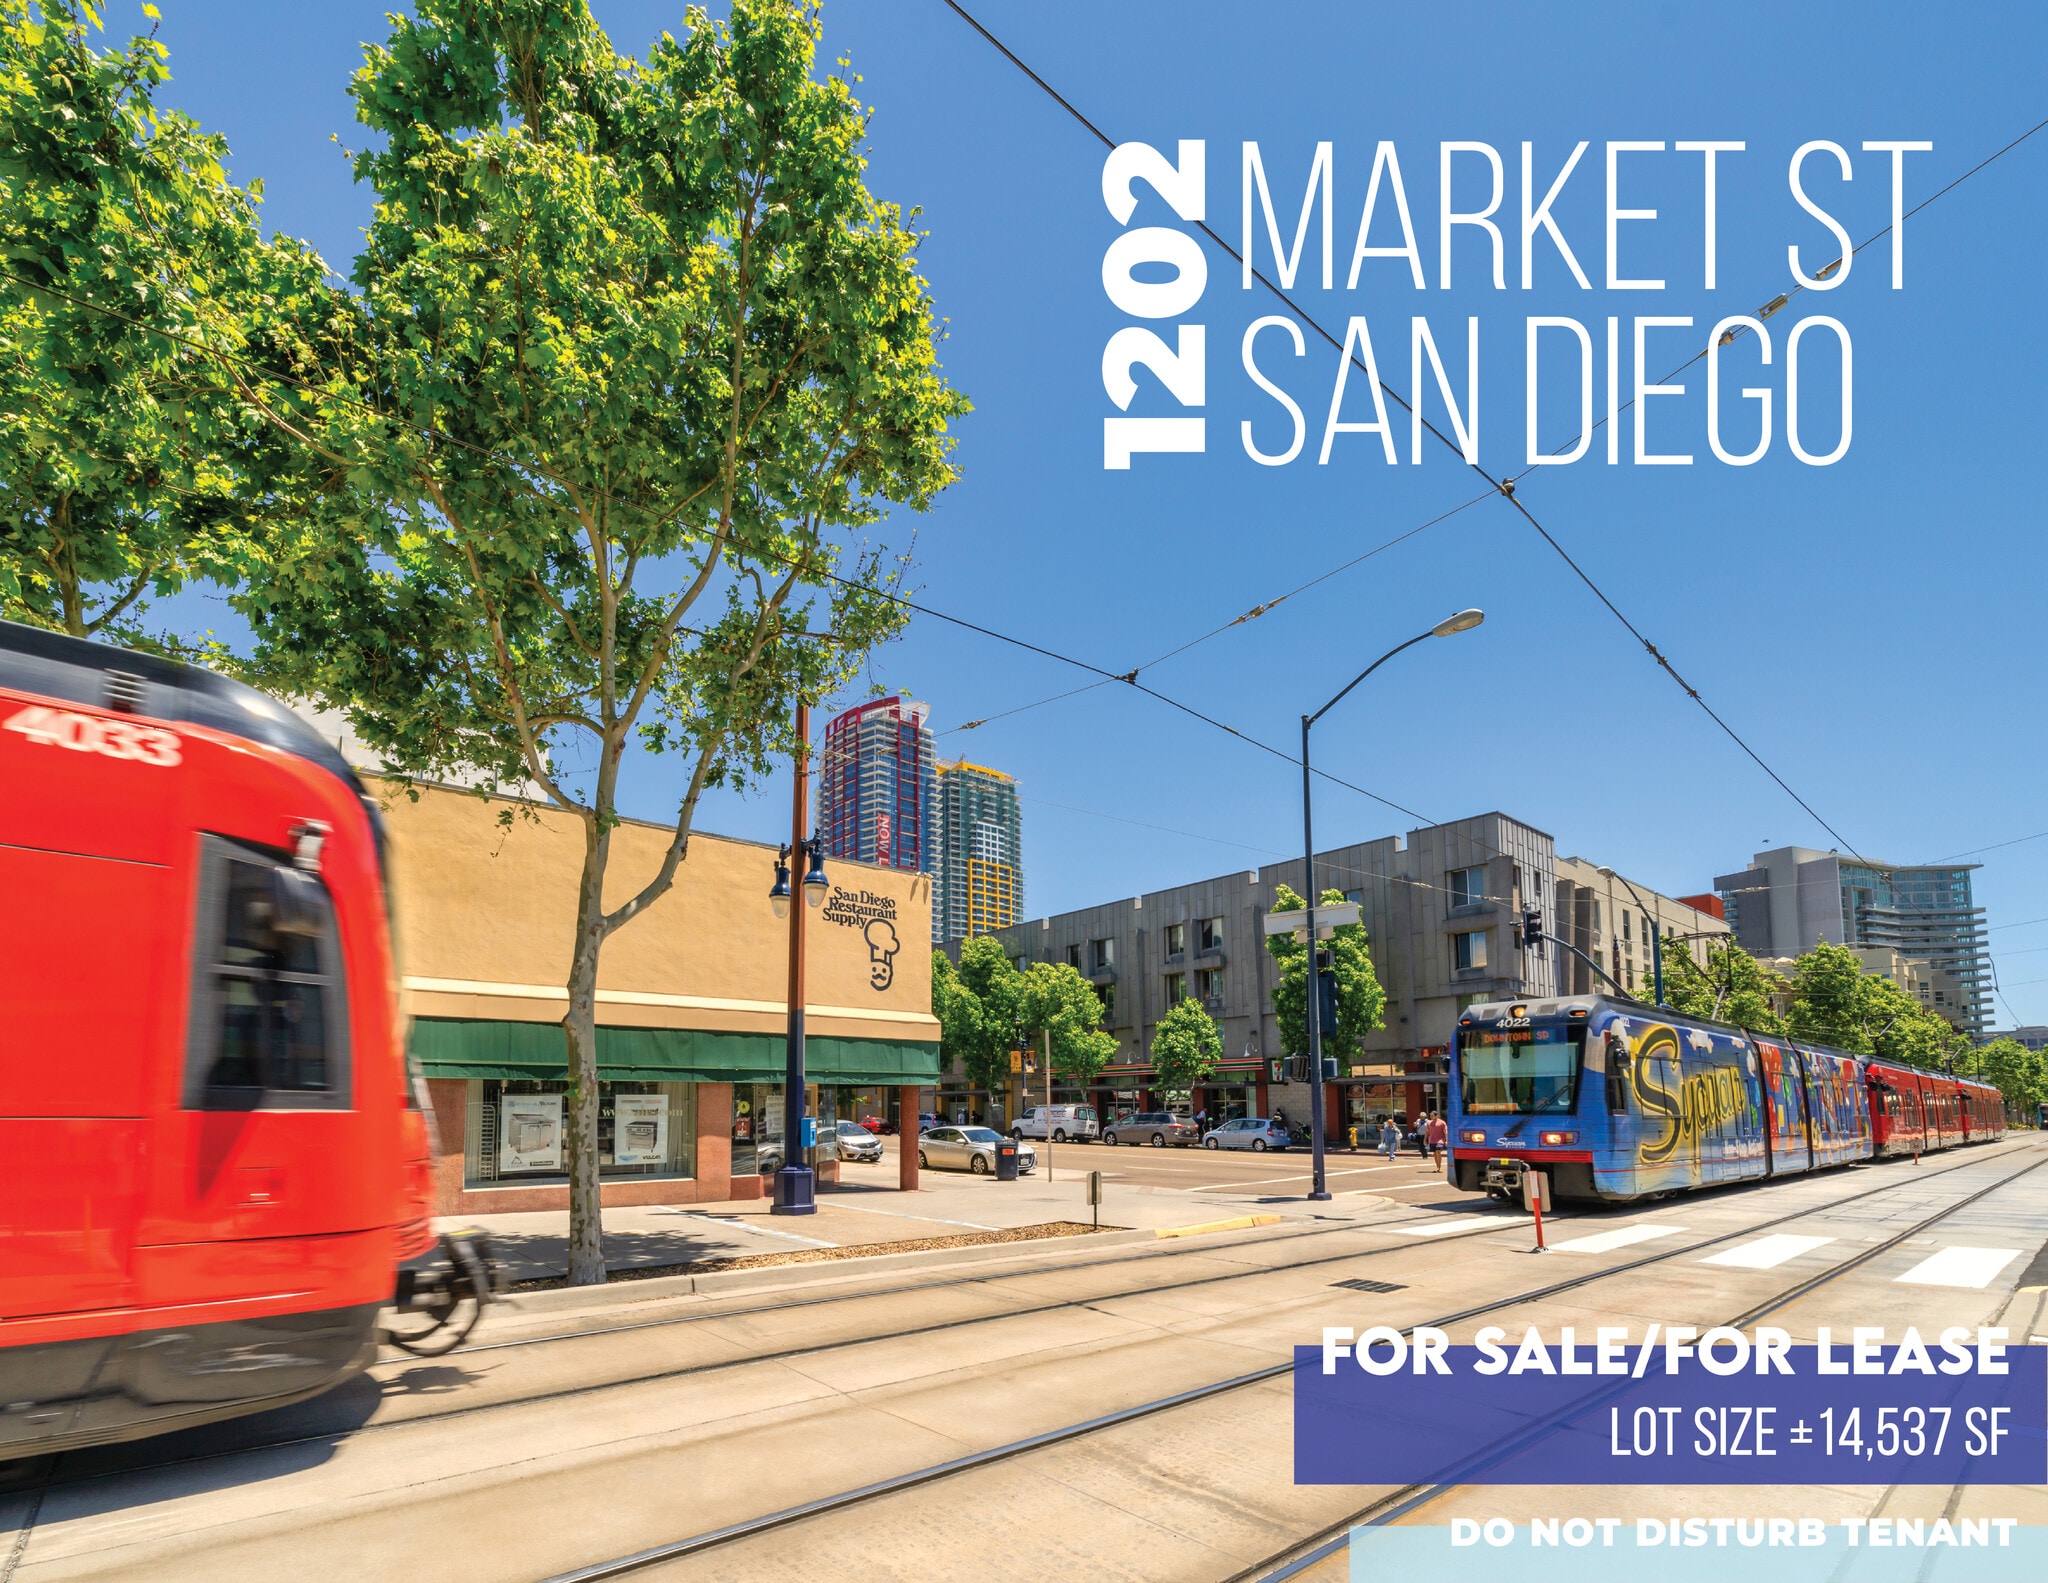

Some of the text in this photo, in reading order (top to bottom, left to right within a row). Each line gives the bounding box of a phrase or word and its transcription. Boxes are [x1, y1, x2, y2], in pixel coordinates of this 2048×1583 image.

[2, 705, 183, 767] 4033
[879, 817, 890, 854] NOW
[828, 896, 897, 920] Restaurant
[834, 886, 896, 909] San Diego
[822, 907, 867, 929] Supply
[1496, 1017, 1531, 1028] 4022
[1483, 1030, 1549, 1043] DOWNTOWN SD
[1496, 1137, 1527, 1148] Sycuan
